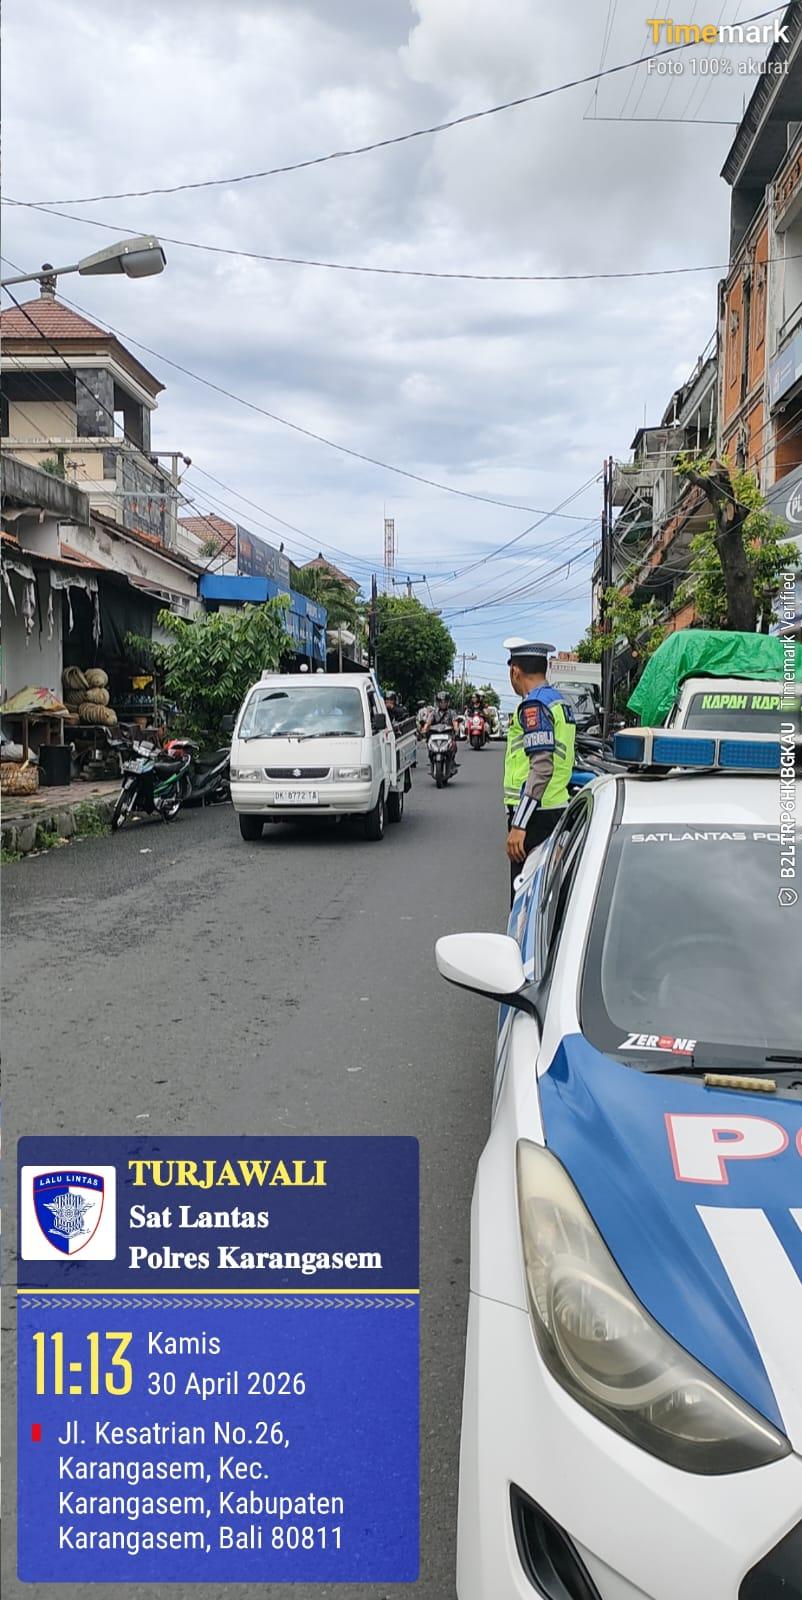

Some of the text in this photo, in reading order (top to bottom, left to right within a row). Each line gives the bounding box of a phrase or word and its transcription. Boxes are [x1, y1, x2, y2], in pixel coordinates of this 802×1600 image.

[702, 695, 747, 709] KAPAH
[275, 791, 284, 799] DK
[632, 832, 746, 842] SATLANTAS
